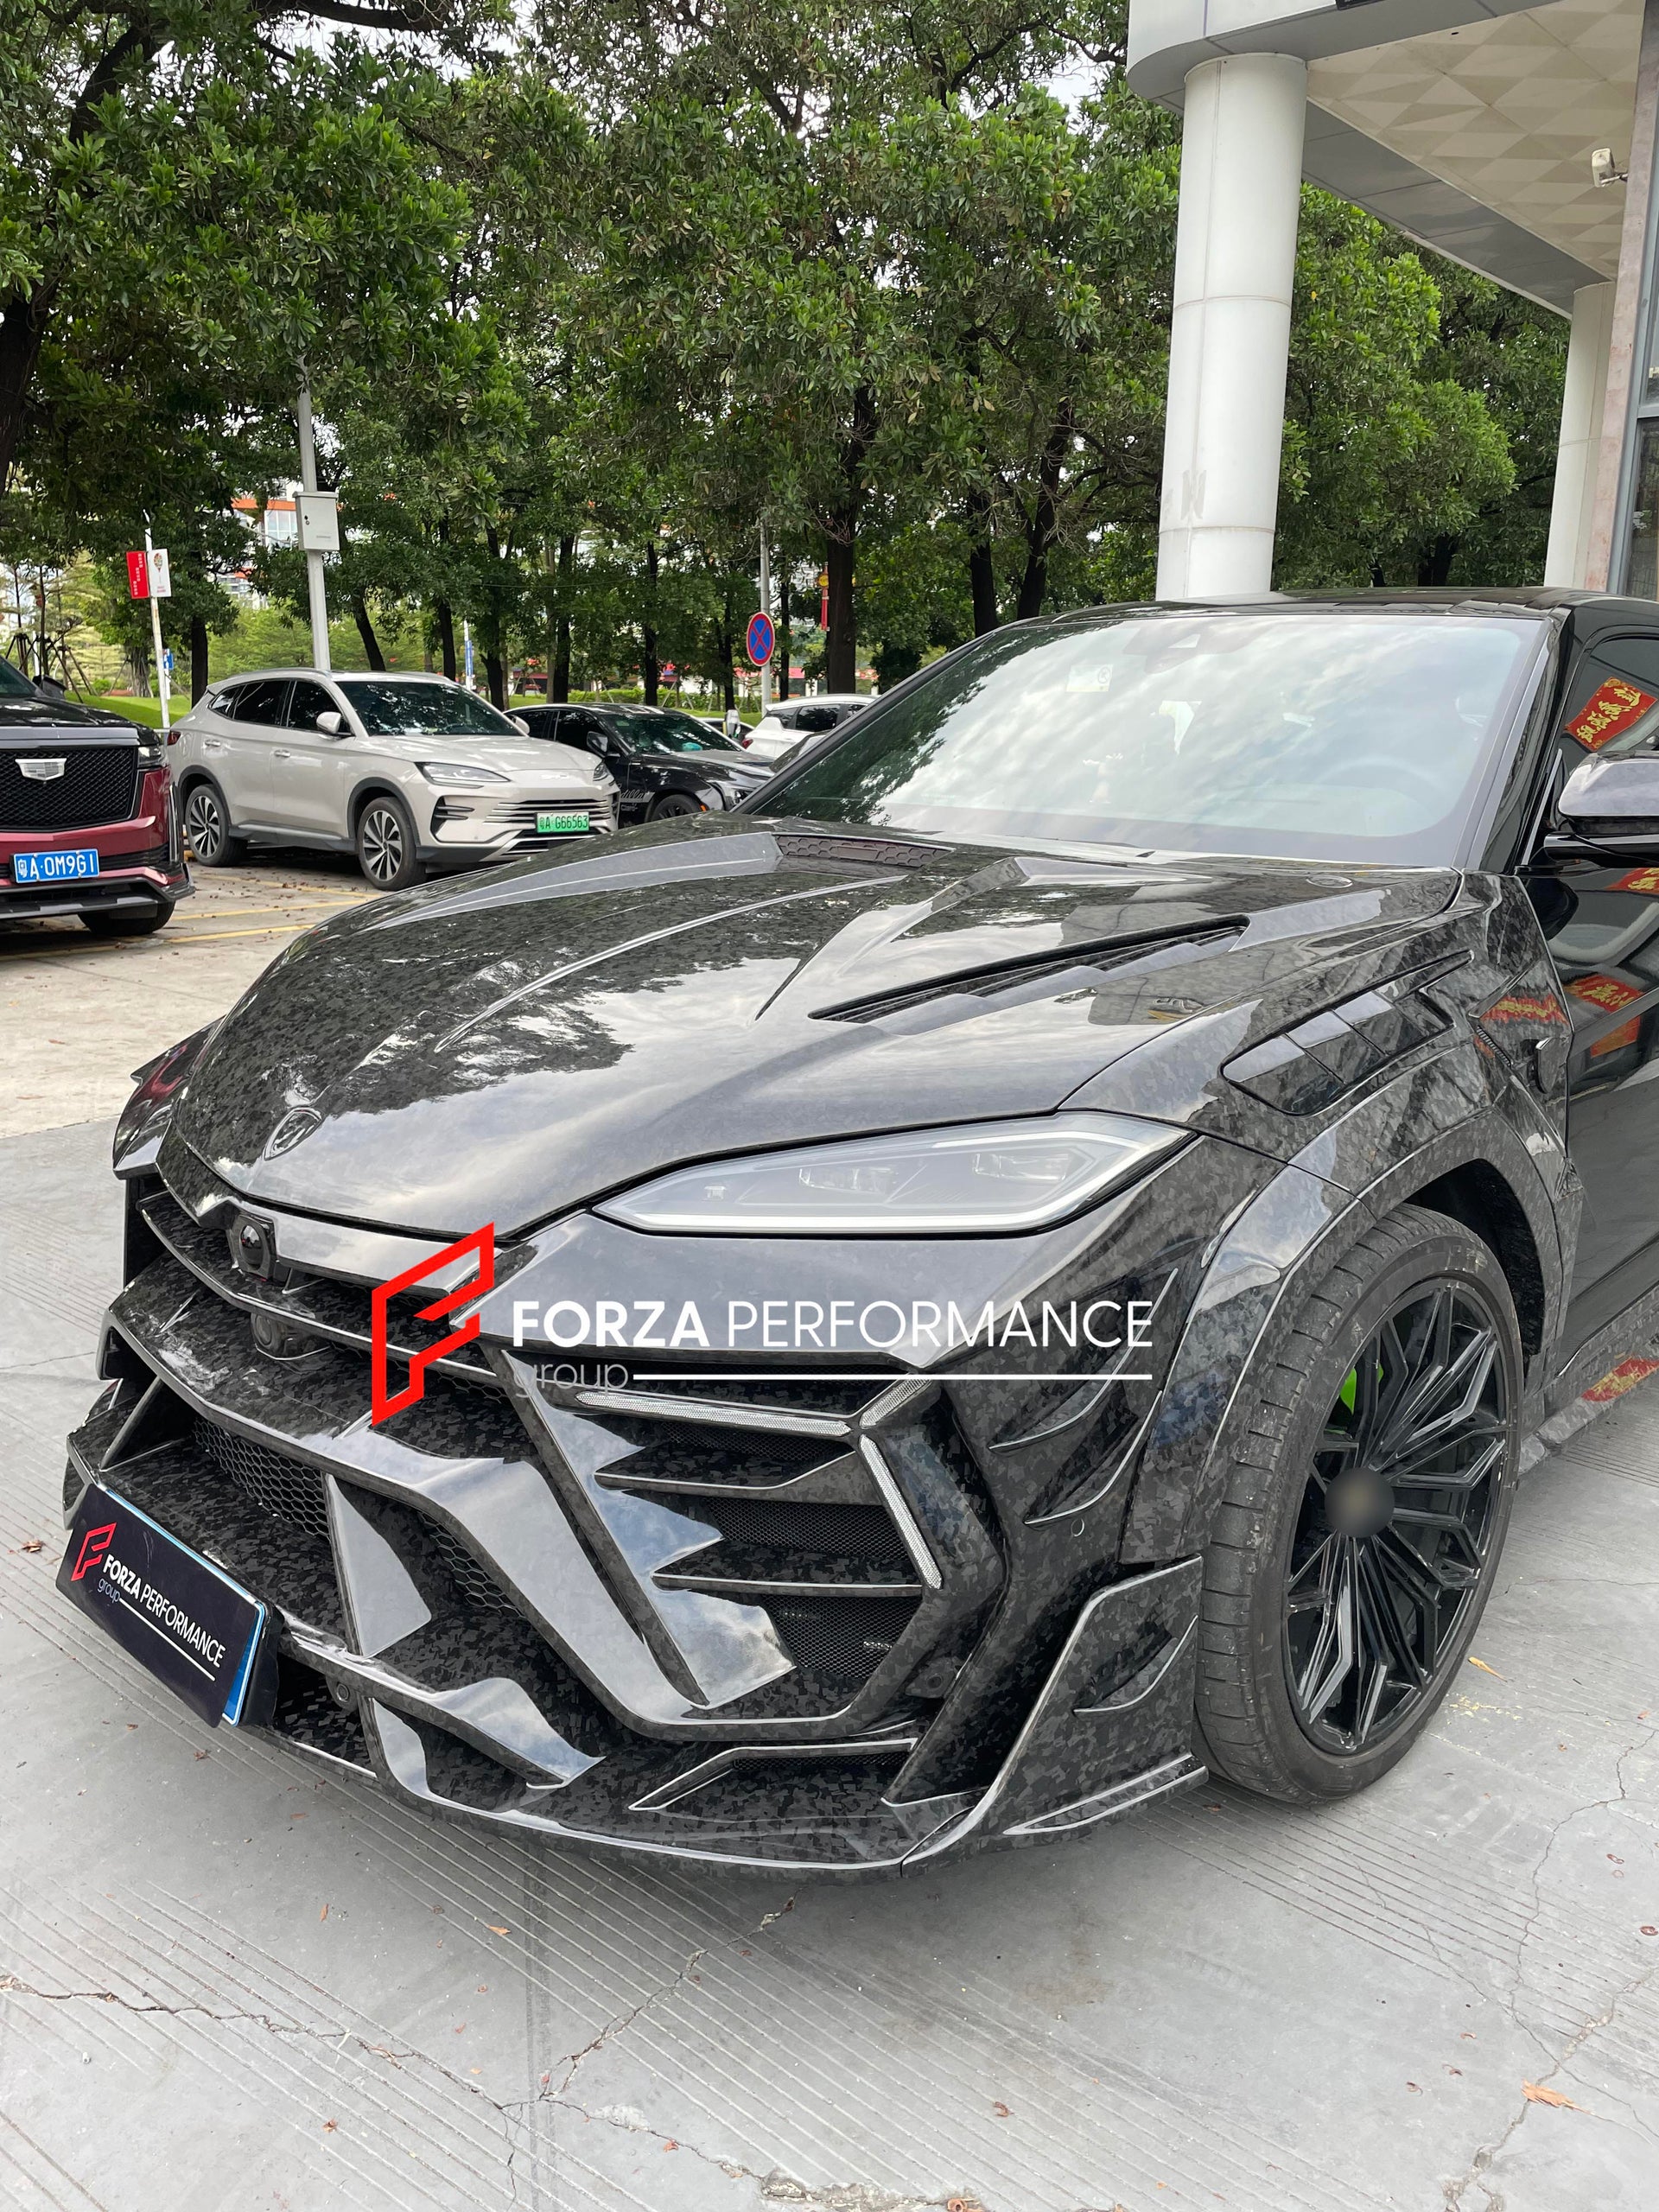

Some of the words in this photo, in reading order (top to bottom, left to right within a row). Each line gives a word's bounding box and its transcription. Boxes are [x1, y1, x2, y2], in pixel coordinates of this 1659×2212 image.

[97, 1577, 121, 1602] group
[102, 1554, 140, 1599] FORZA
[140, 1584, 226, 1669] PERFORMANCE
